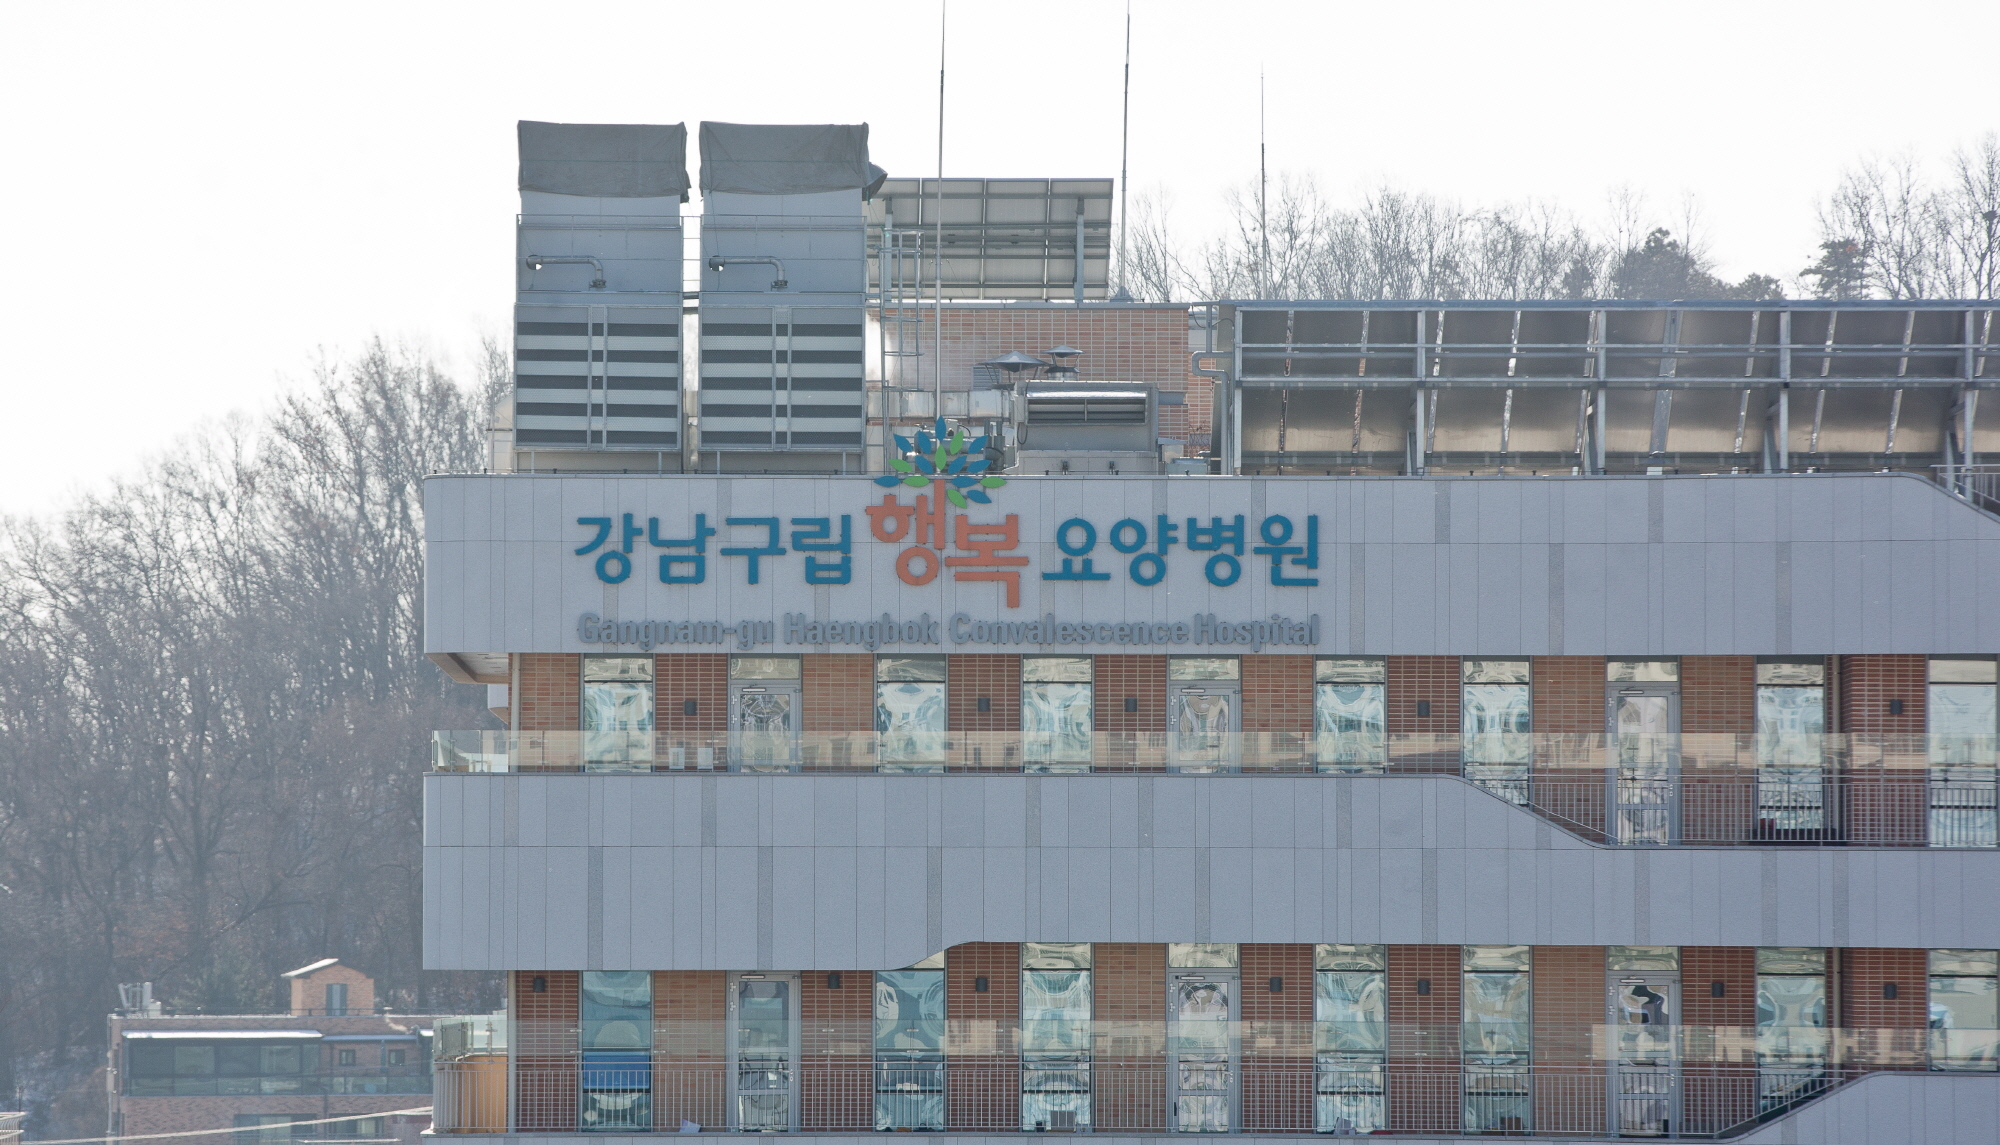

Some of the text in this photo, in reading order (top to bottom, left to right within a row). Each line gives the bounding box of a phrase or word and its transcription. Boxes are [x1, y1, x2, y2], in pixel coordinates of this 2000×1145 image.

[576, 479, 1319, 608] 강남구립 행복 요양병원
[578, 612, 1320, 652] Gangnam-gu Haengbok Convalescence Hospital
